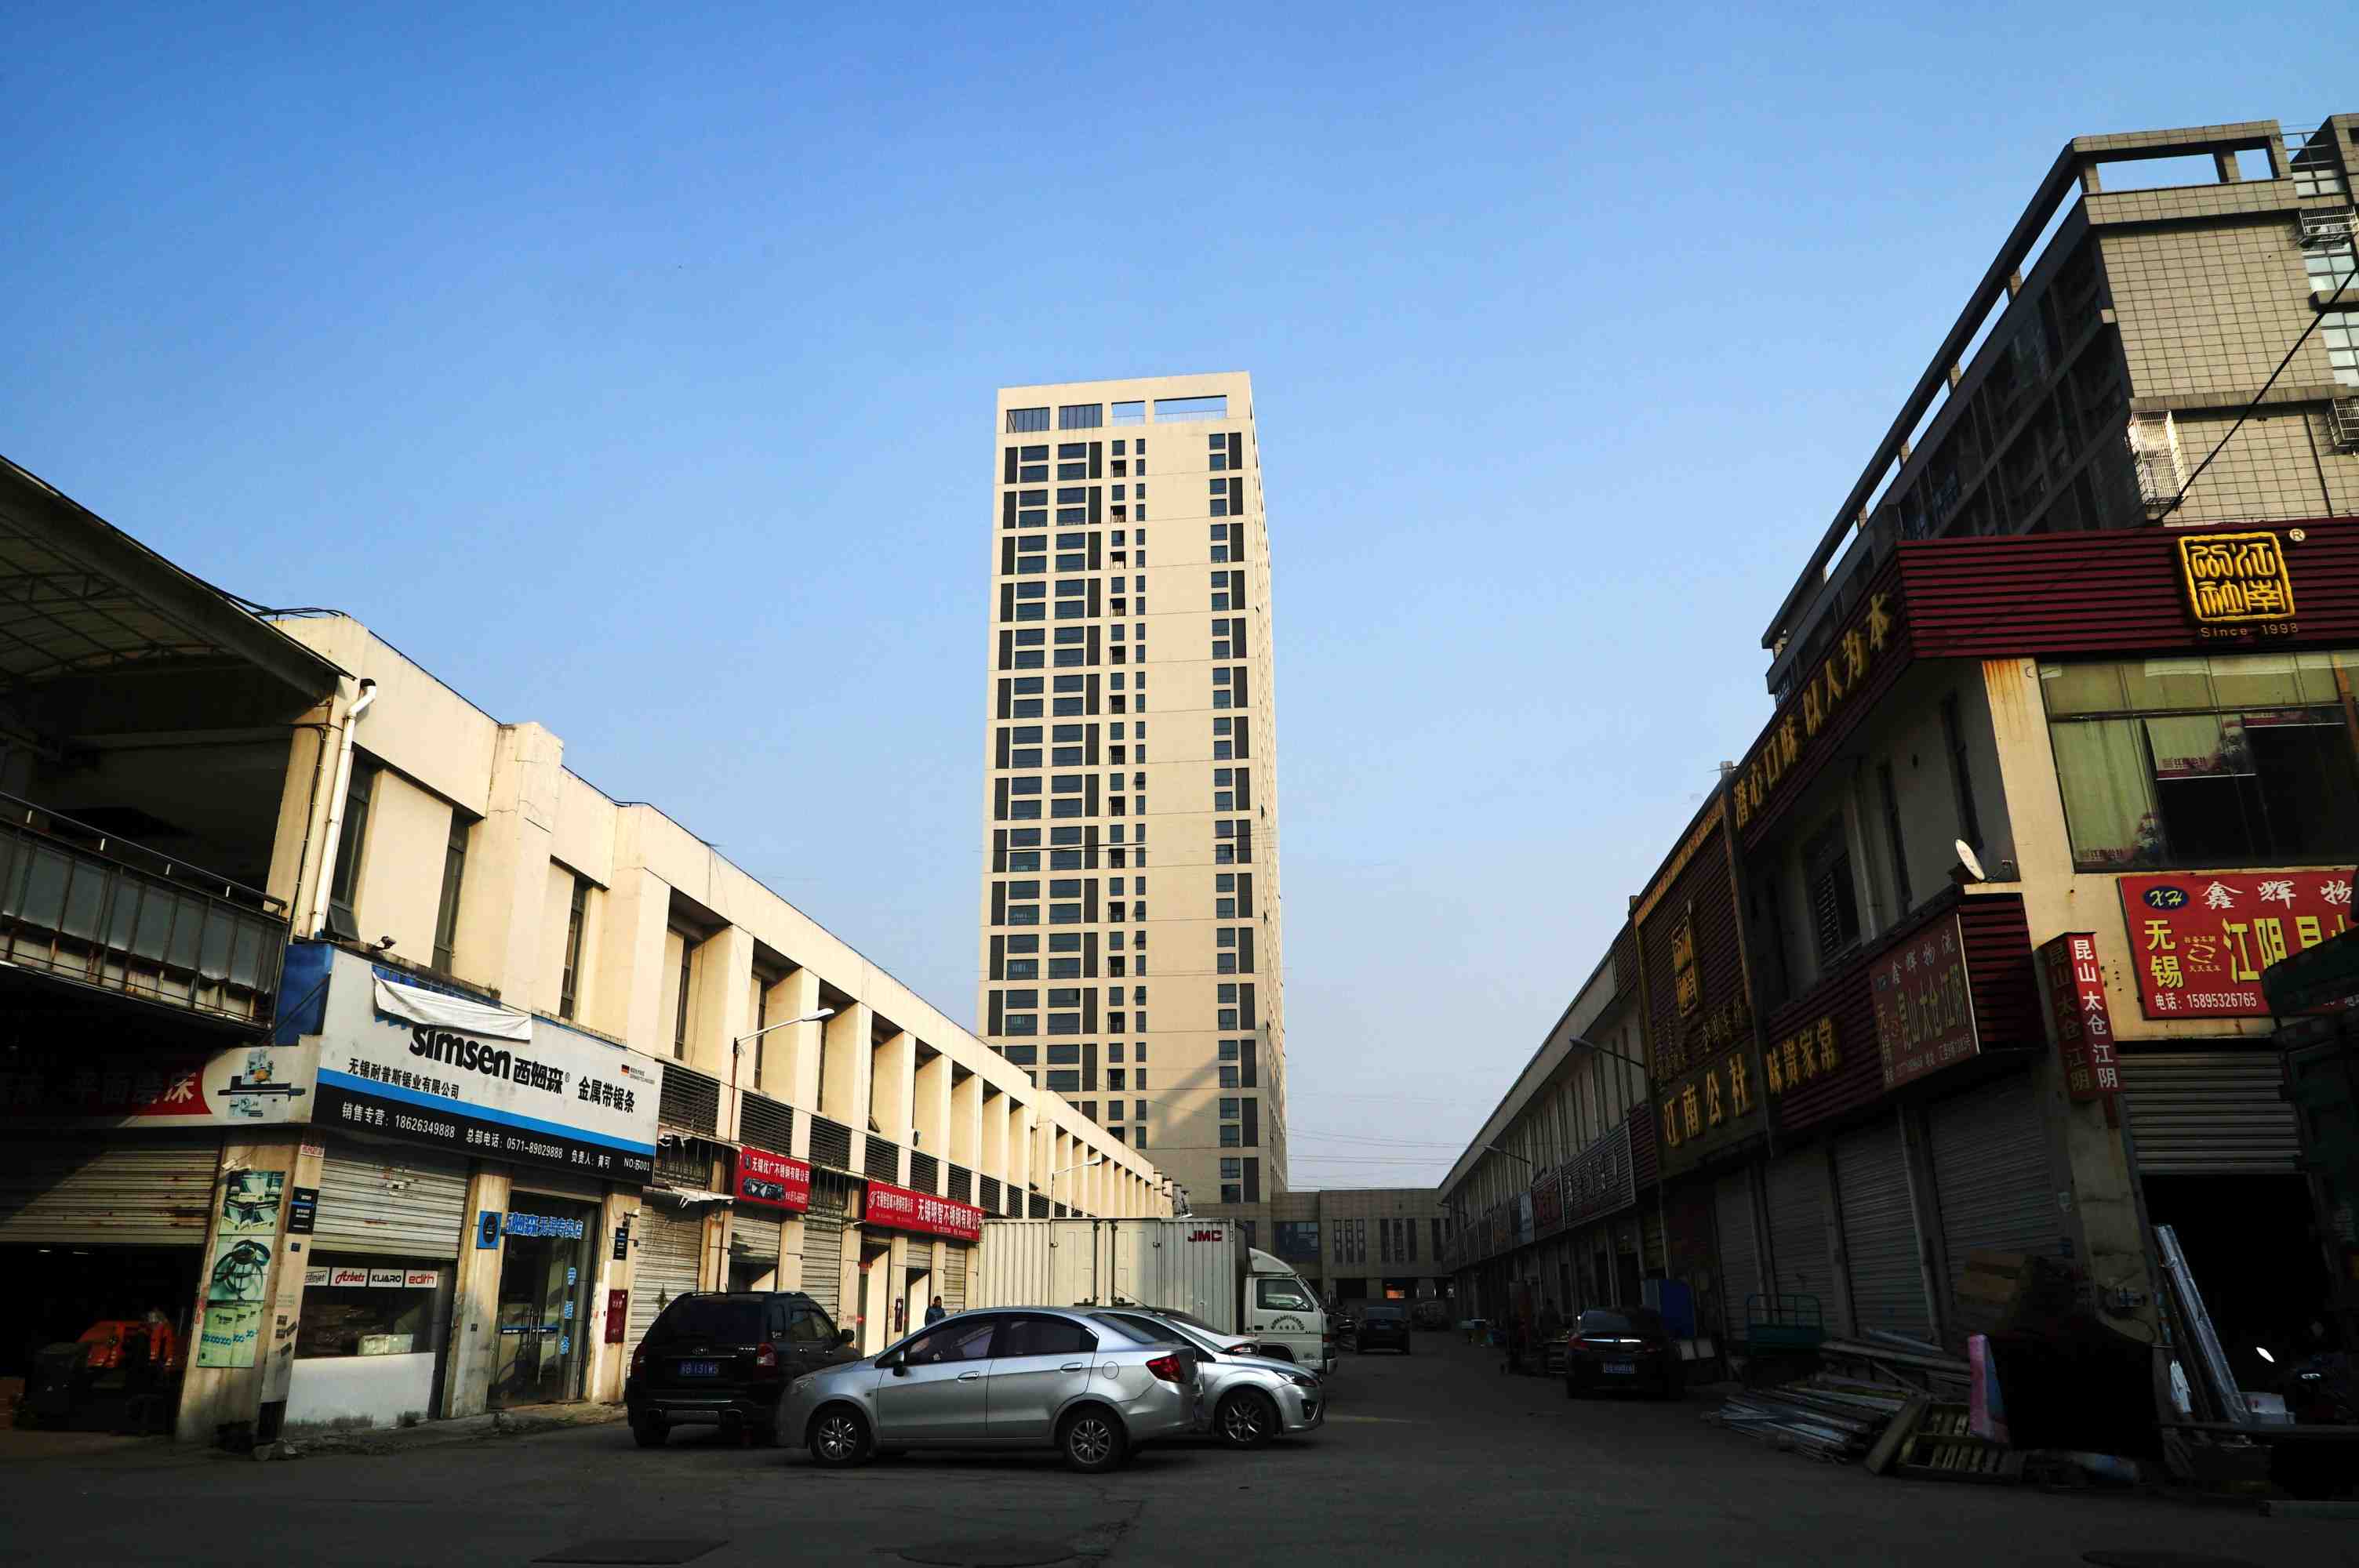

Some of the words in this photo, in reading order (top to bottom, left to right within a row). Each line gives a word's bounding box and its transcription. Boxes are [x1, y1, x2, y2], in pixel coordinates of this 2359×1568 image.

[2200, 626, 2248, 638] Since
[2261, 622, 2299, 636] 1998
[2073, 938, 2097, 983] 昆山
[2144, 920, 2184, 989] 无锡
[2082, 990, 2108, 1036] 太仓
[2186, 992, 2257, 1008] 15895326765
[513, 1057, 564, 1095] 西姆森
[577, 1075, 635, 1114] 金属带锯条
[2092, 1044, 2119, 1090] 江阴
[1663, 1054, 1753, 1149] 江南公社
[394, 1114, 456, 1138] 18626349888
[506, 1137, 564, 1160] 0571-89029888
[1187, 1229, 1223, 1243] JMC
